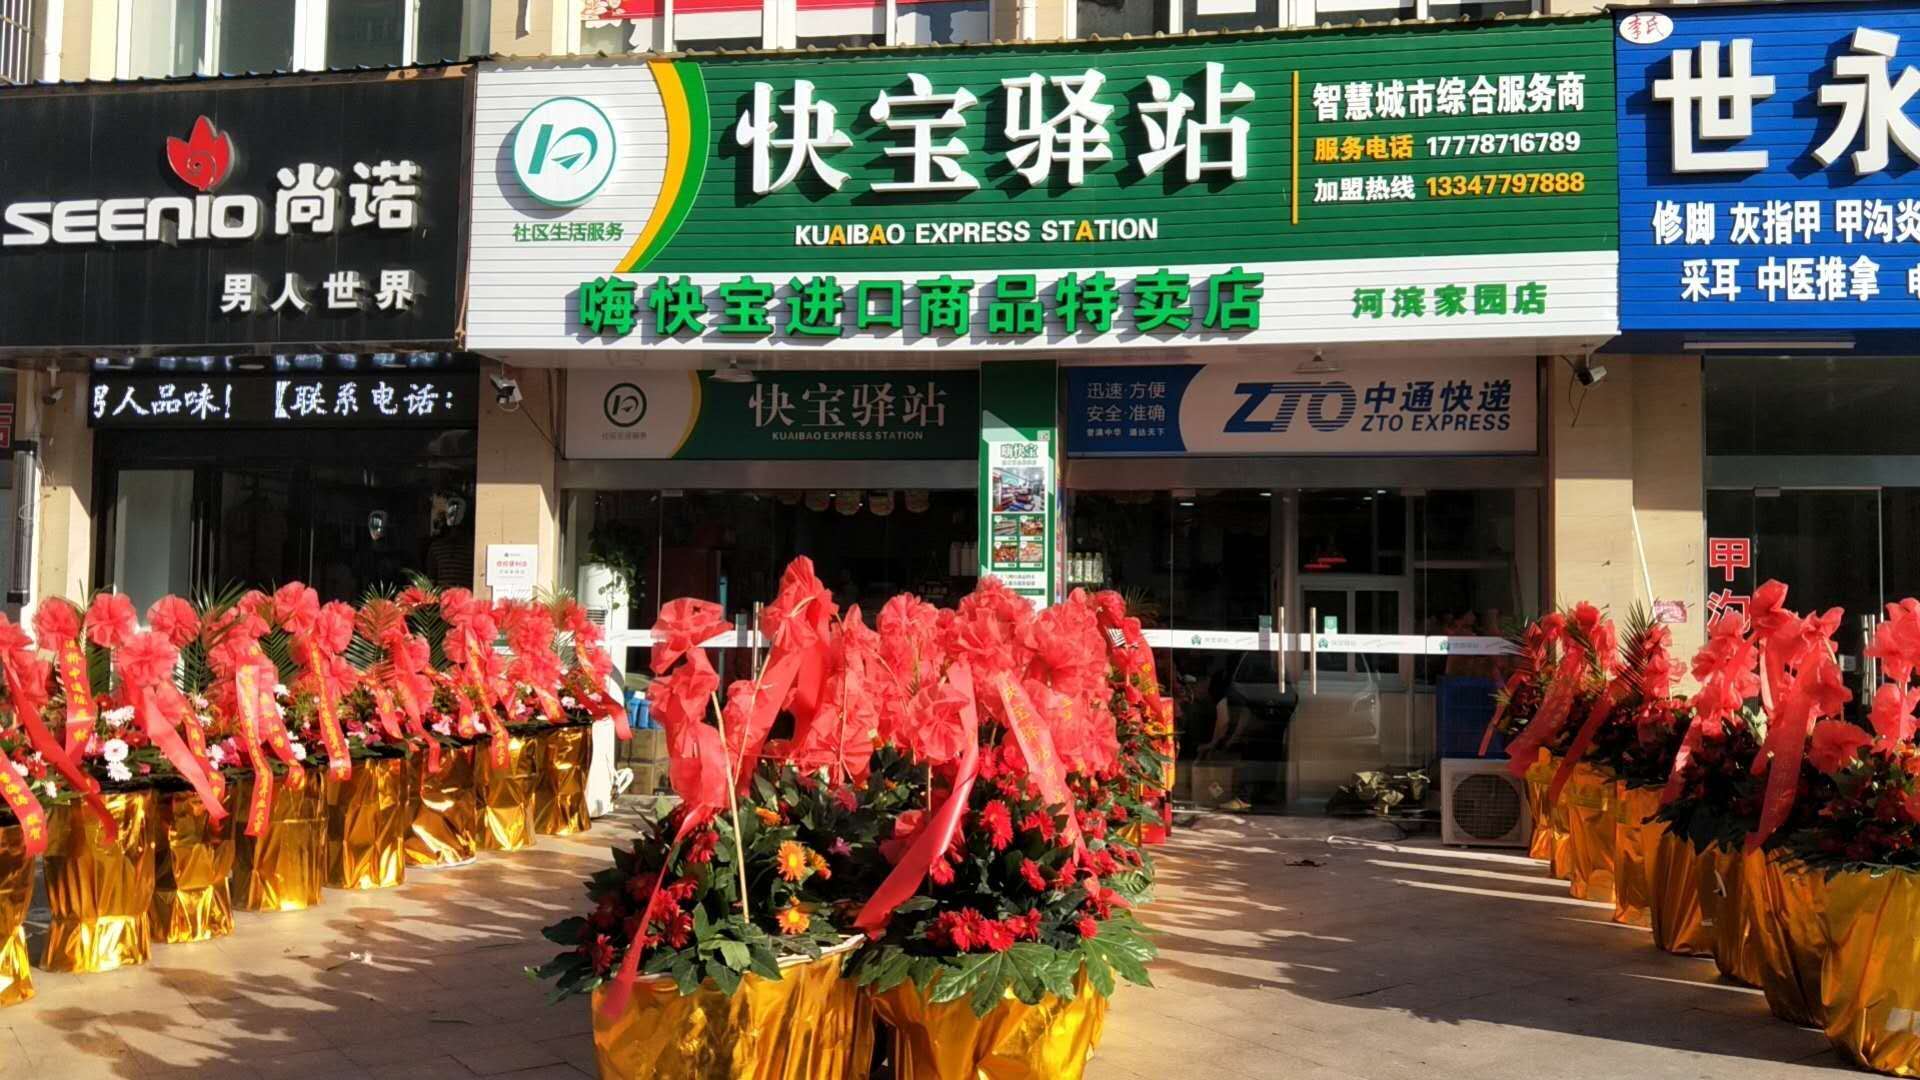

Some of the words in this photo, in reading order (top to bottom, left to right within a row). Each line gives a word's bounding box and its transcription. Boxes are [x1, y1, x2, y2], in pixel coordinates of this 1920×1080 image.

[1313, 72, 1586, 122] 智慧城市综合服务商
[1653, 26, 1920, 178] 世永
[736, 62, 1255, 196] 快宝驿站
[1314, 134, 1414, 162] 服务电话
[1426, 131, 1581, 156] 17778716789
[275, 160, 420, 236] 尚诺
[1314, 175, 1416, 203] 加盟热线
[1426, 172, 1585, 197] 13347797888
[513, 222, 625, 244] 社区生活服务
[795, 222, 906, 247] KUAIBAO
[915, 221, 1031, 245] EXPRESS
[1041, 217, 1159, 242] STATION
[1652, 200, 1715, 245] 修脚
[1730, 200, 1821, 245] 灰指甲
[1835, 198, 1920, 243] 甲沟炎
[221, 269, 414, 313] 男人世界
[1352, 281, 1548, 320] 河滨家园店
[1681, 258, 1741, 302] 采耳
[1757, 254, 1881, 302] 中医推拿
[579, 266, 1264, 336] 嗨快宝进口商品特卖店
[749, 382, 949, 428] 快宝驿站
[1223, 381, 1357, 432] ZTO
[1363, 380, 1512, 412] 中通快递
[772, 431, 822, 441] KUAIBAO
[824, 431, 872, 441] EXPRESS
[875, 431, 923, 441] STATION
[1361, 415, 1403, 431] ZTO
[1411, 414, 1511, 431] EXPRESS
